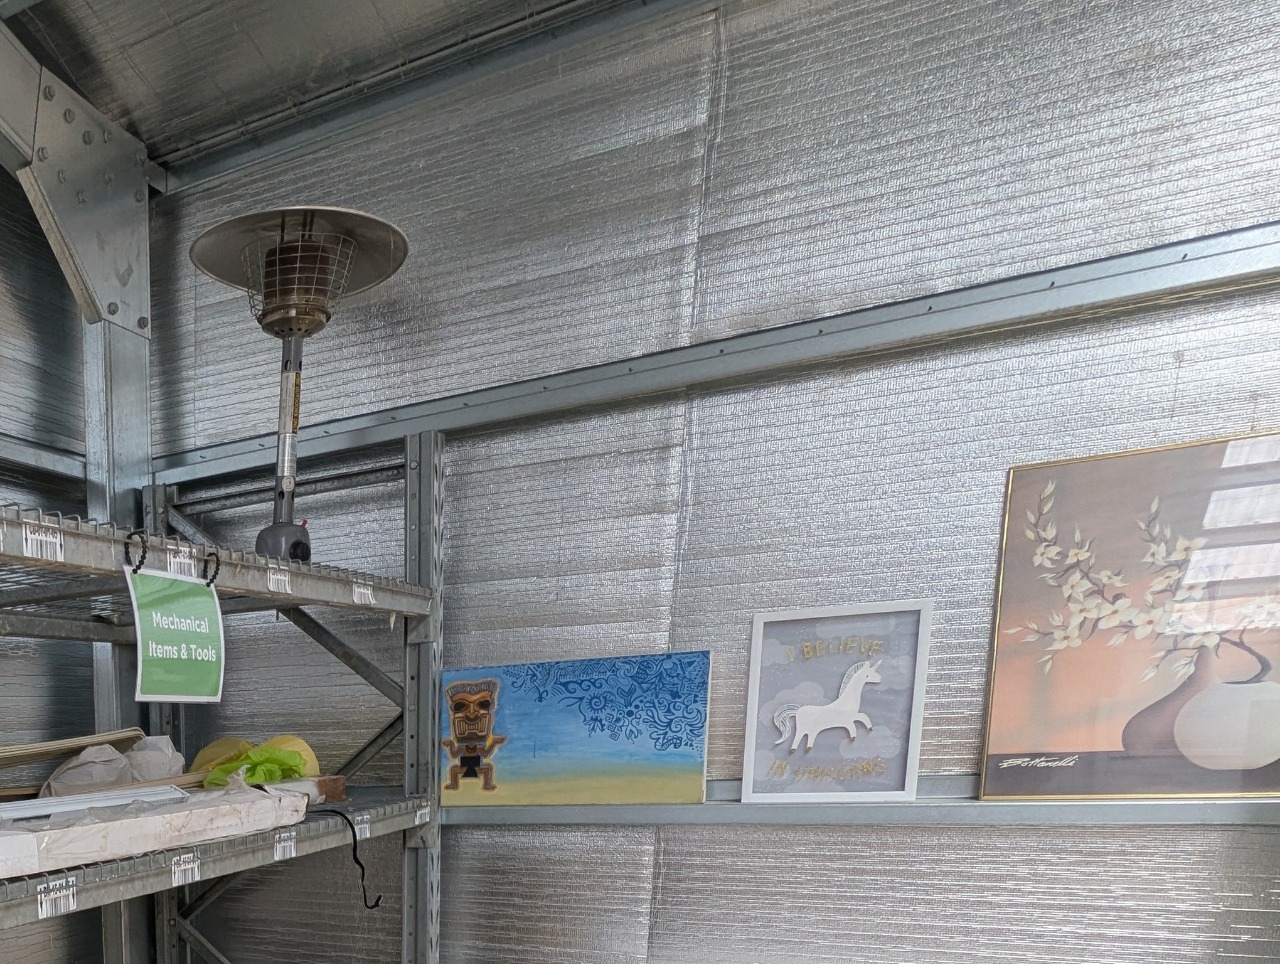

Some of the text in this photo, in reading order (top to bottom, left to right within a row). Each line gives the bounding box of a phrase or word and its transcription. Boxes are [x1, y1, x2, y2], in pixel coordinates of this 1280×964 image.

[152, 611, 209, 633] Mechanical
[149, 640, 216, 661] Items & Tools
